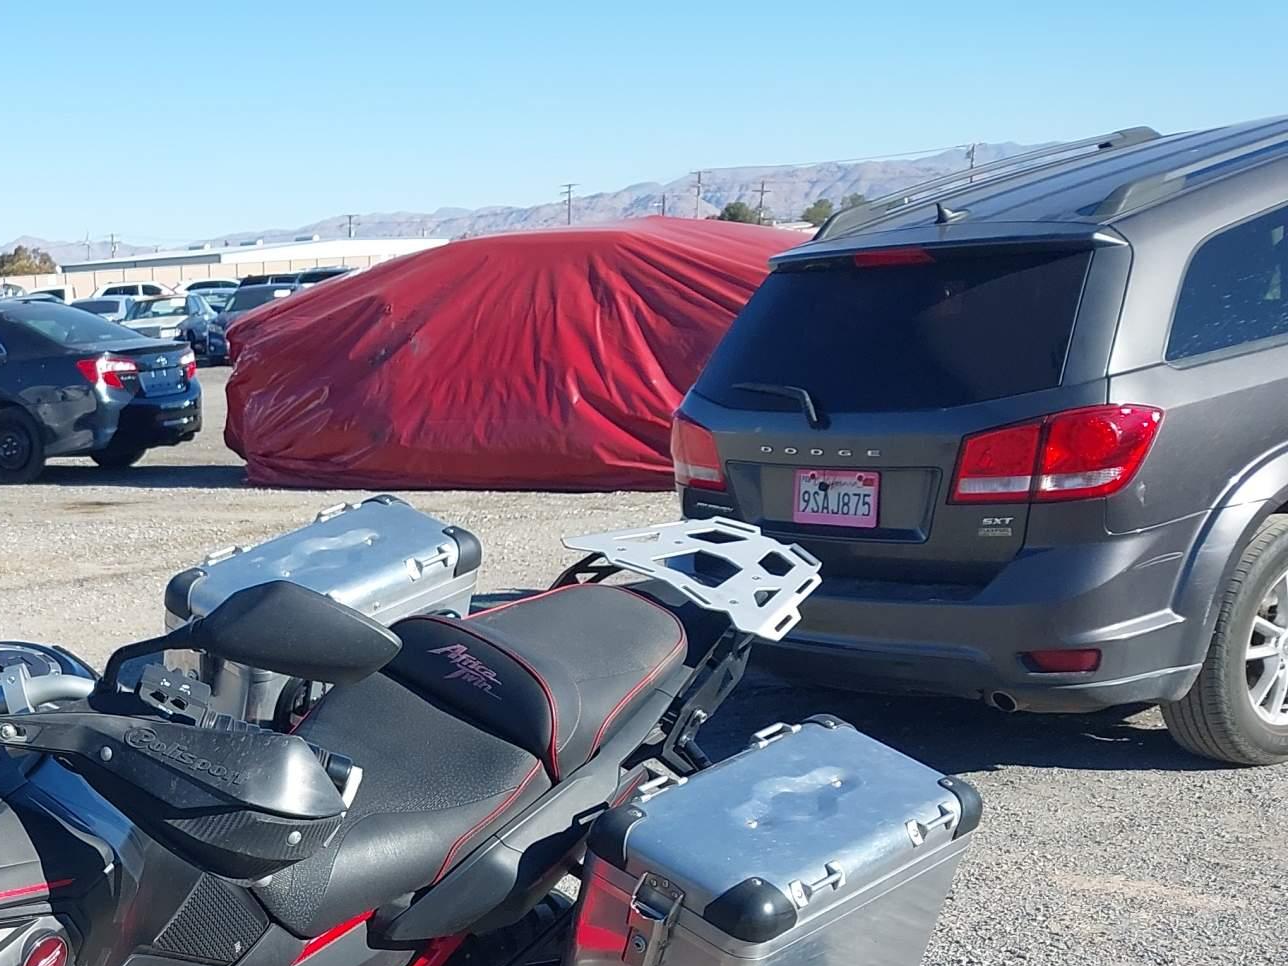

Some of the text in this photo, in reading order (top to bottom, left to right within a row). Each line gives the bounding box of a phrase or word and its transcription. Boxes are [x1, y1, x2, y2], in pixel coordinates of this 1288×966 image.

[760, 446, 881, 457] DODGE
[801, 490, 872, 517] 9SAJ875
[982, 517, 1014, 525] SXT
